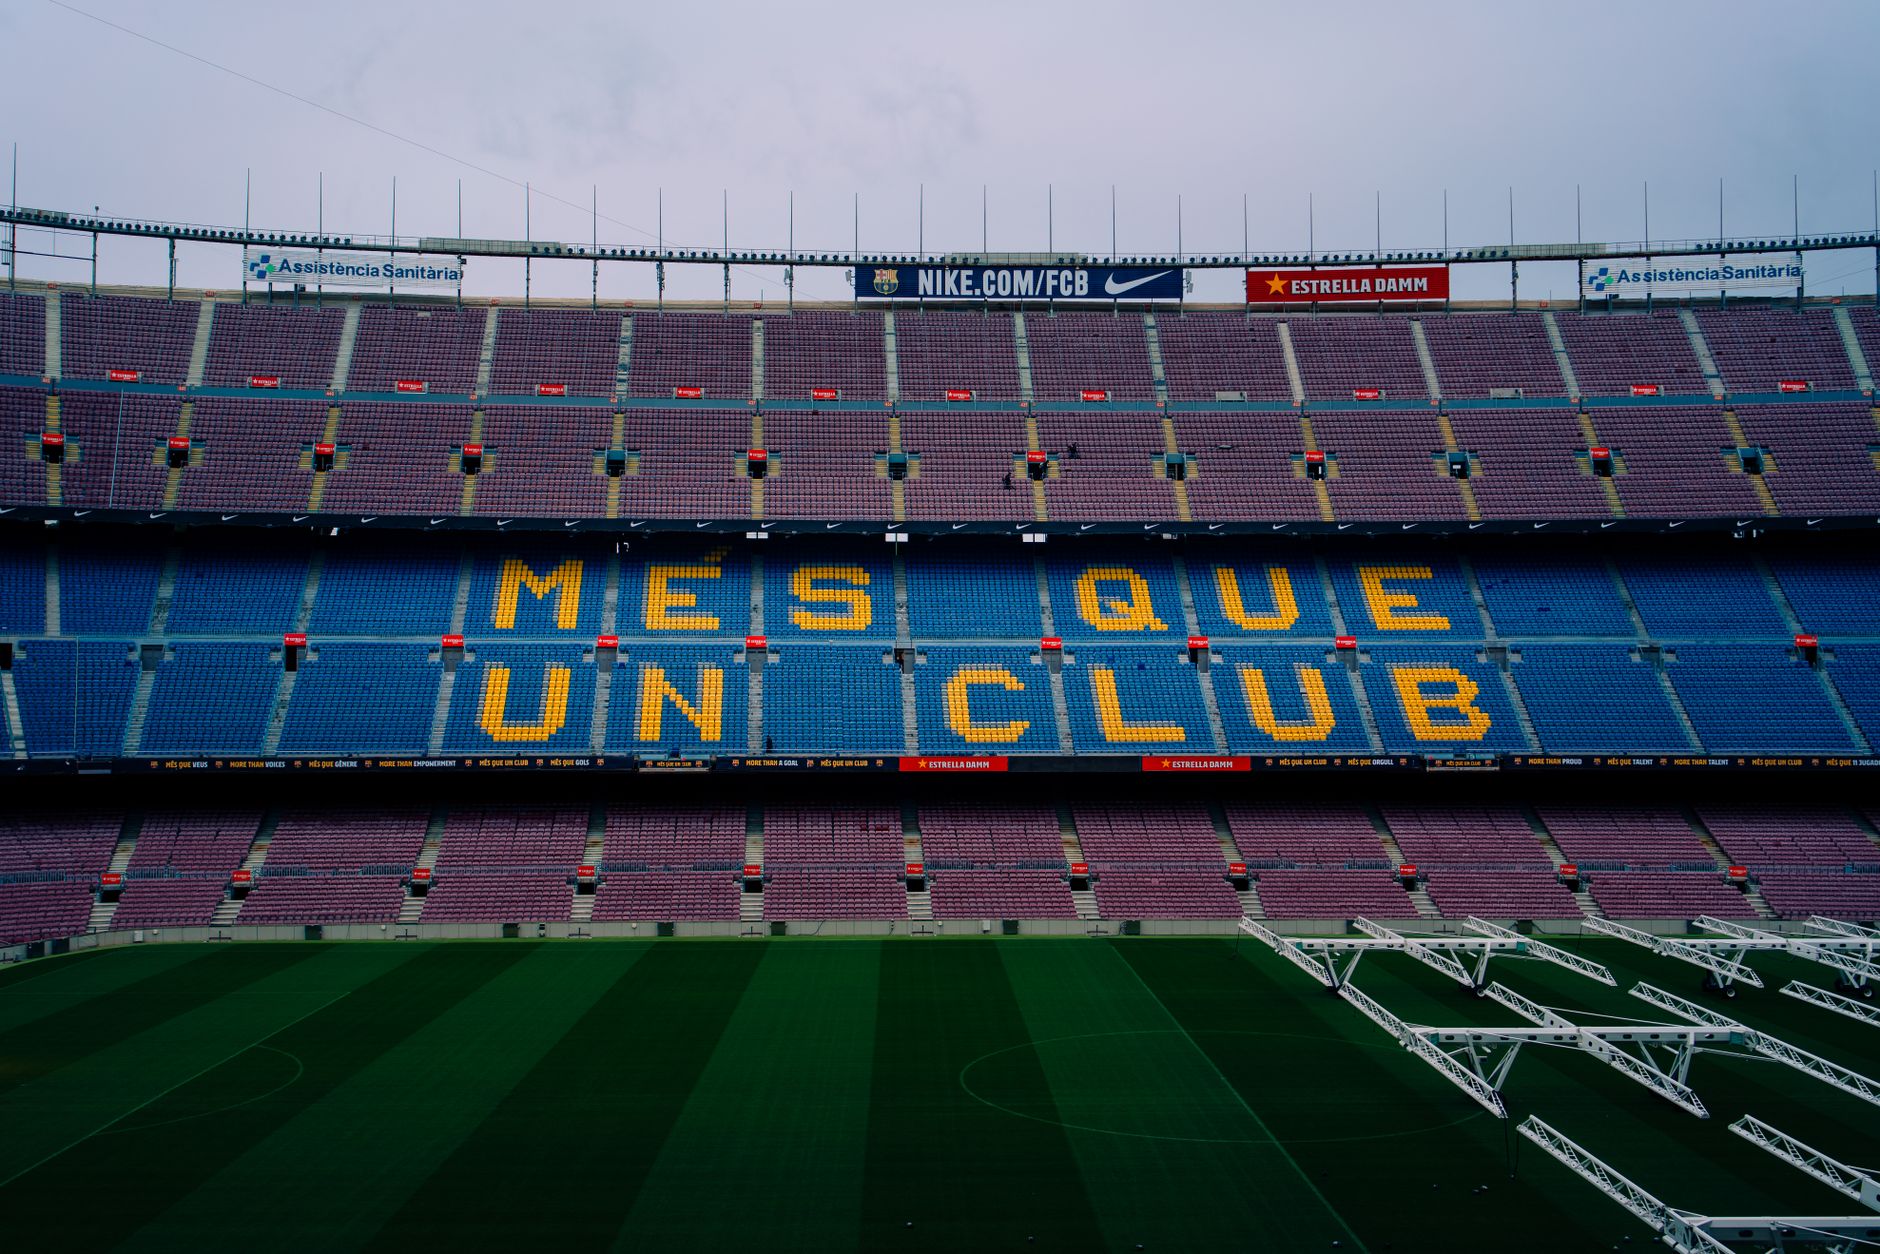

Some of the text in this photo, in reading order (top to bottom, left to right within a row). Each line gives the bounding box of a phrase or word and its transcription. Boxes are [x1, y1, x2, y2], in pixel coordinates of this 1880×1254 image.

[279, 258, 458, 281] Assistència Sanitària
[1617, 263, 1801, 284] Assistència Sanitària
[917, 269, 1089, 297] NIKE.COM/FCB
[1291, 277, 1428, 295] ESTRELLA DAMM
[490, 546, 1453, 632] MÉS QUE
[475, 662, 1492, 742] UN CLUB
[491, 760, 503, 768] QUE
[832, 760, 844, 768] QUE
[929, 761, 990, 769] ESTRELLA DAMM
[1764, 759, 1777, 767] QUE
